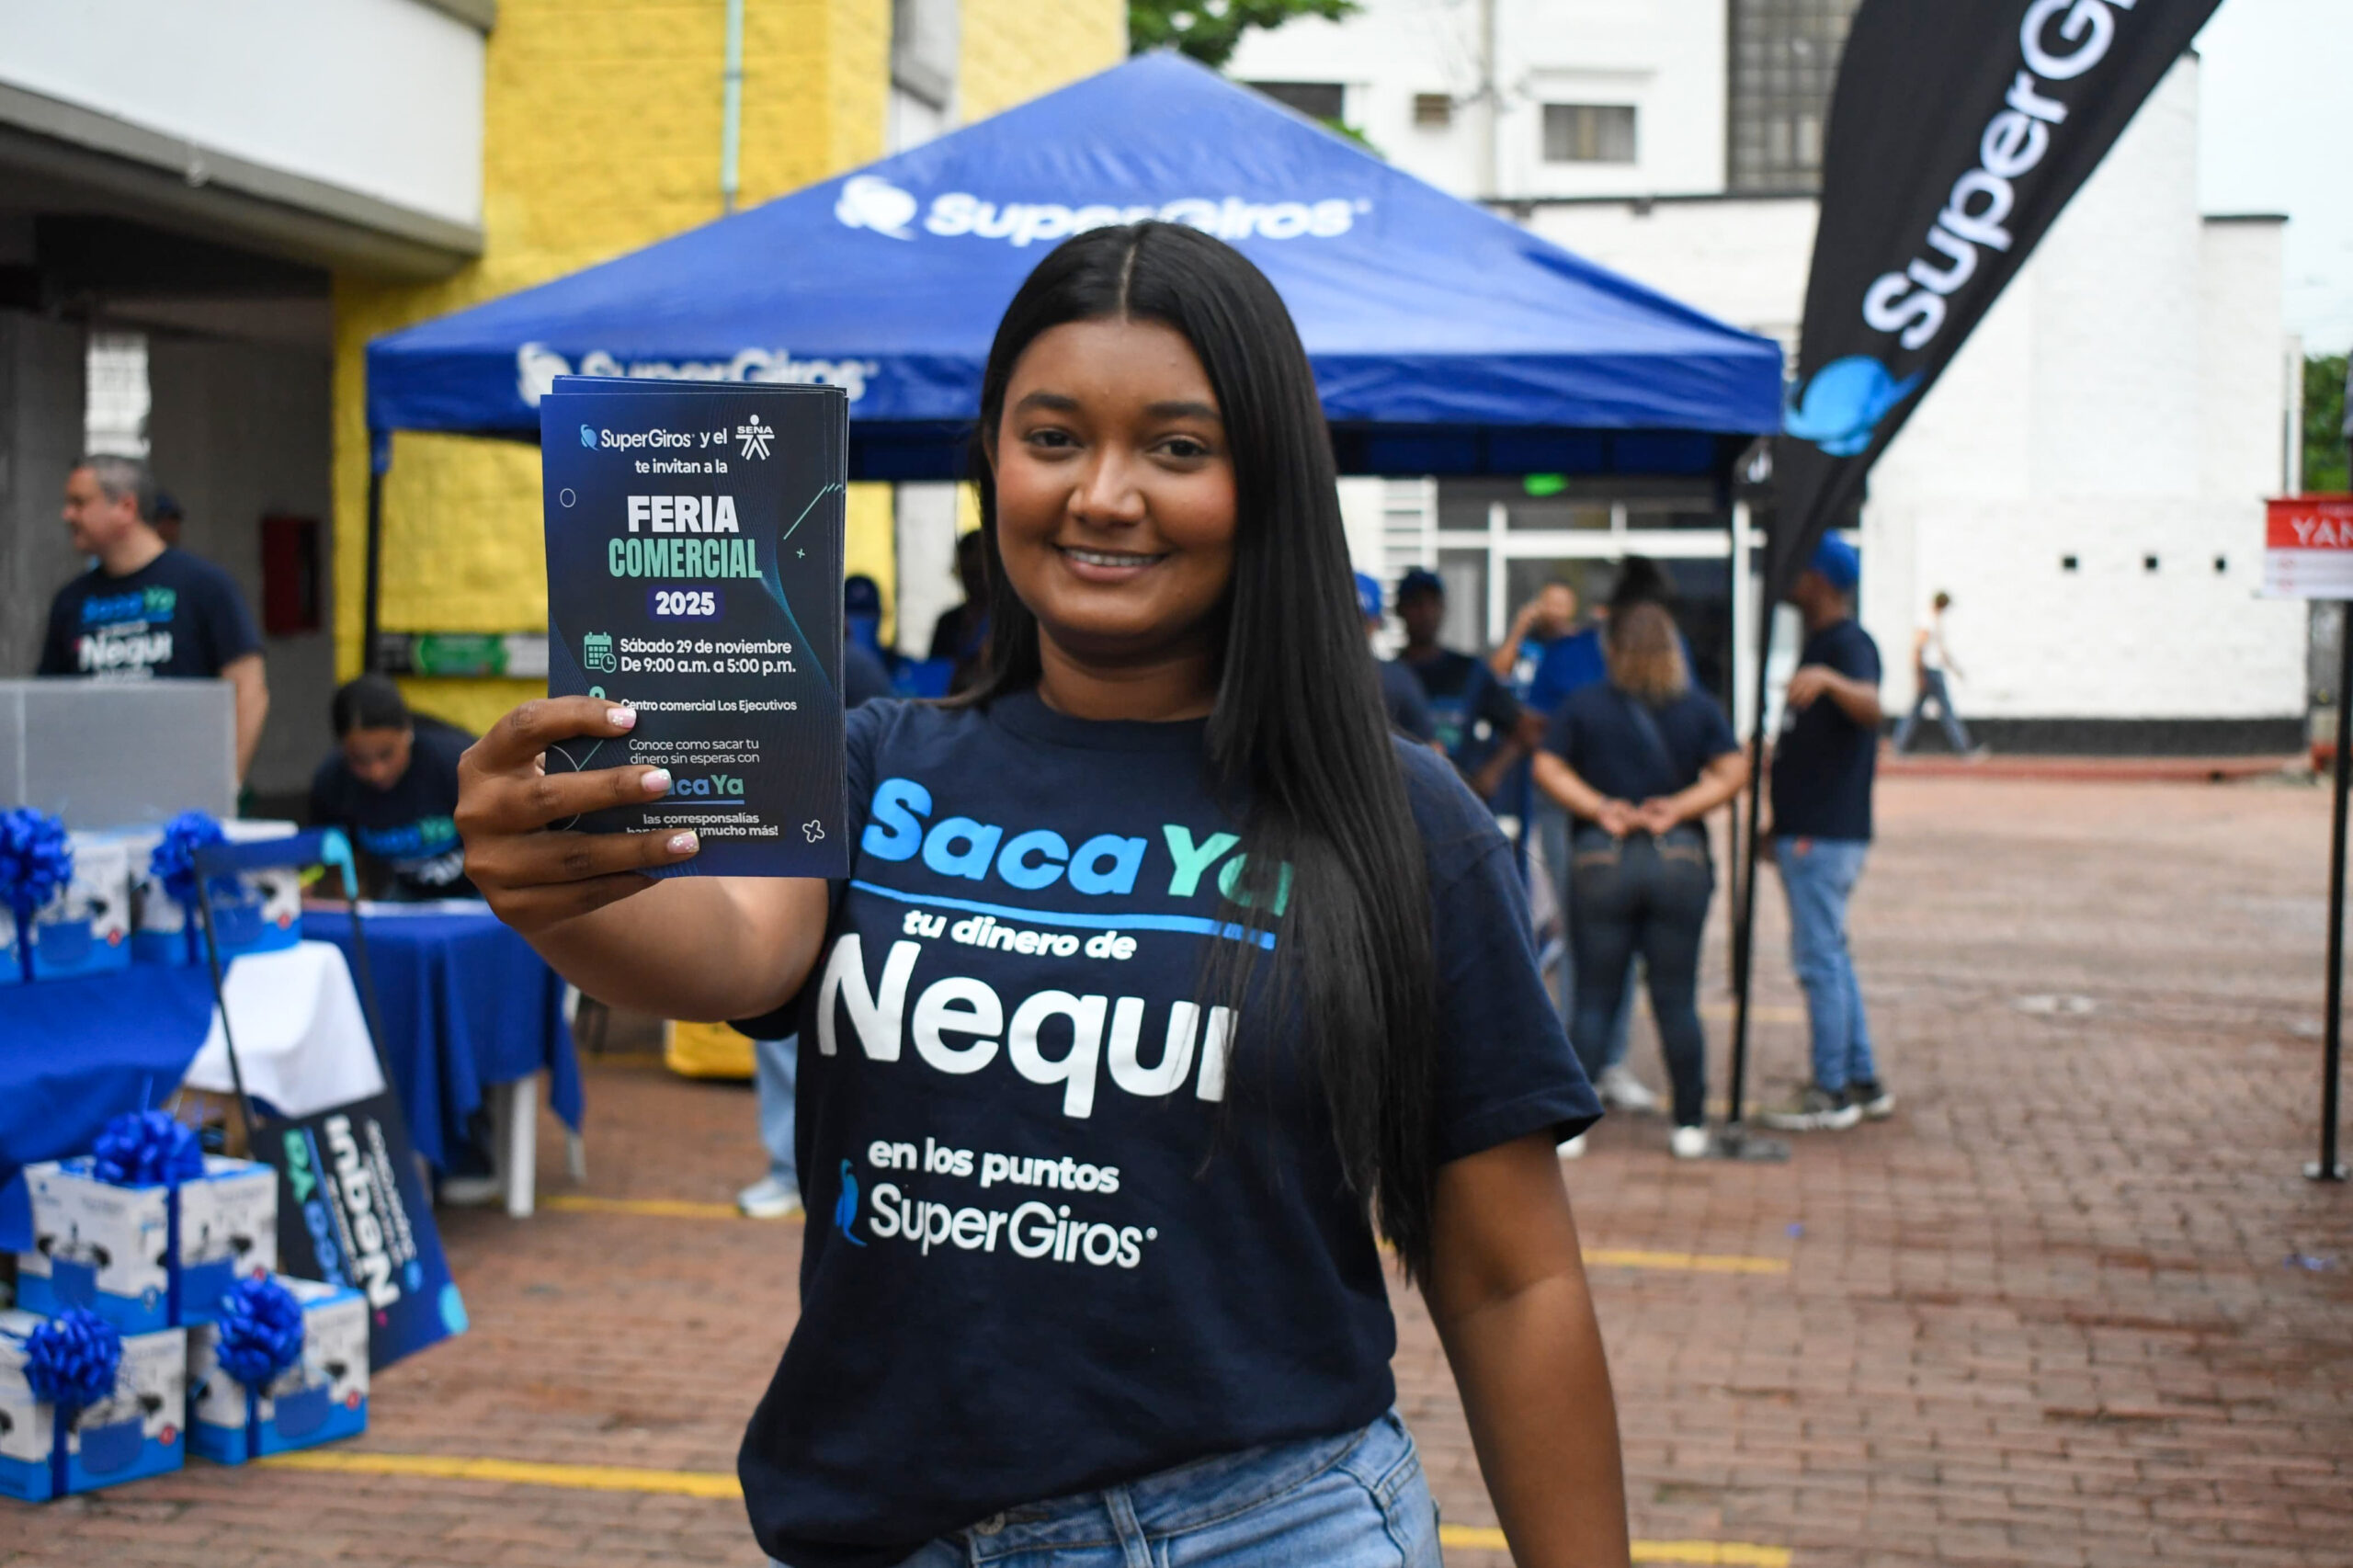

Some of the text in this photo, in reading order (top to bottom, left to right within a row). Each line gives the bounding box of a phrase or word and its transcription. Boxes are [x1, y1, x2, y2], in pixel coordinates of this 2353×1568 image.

[1863, 0, 2137, 349] SuperG
[600, 426, 773, 452] SuperGiros y el SENA
[635, 458, 728, 473] te invitan a la
[627, 495, 739, 533] FERIA
[608, 538, 763, 579] COMERCIAL
[655, 591, 715, 615] 2025
[620, 638, 791, 654] Sábado 29 de noviembre
[620, 656, 796, 676] De 9:00 a.m. a 5:00 p.m.
[661, 700, 716, 711] comercial
[718, 700, 737, 711] Los
[739, 699, 797, 713] Ejecutivos
[629, 739, 759, 750] Conoce como sacar tu
[630, 752, 759, 766] dinero sin esperas con
[668, 775, 744, 796] ca Ya
[643, 812, 759, 826] las corresponsalías
[700, 825, 779, 837] ¡mucho más!
[860, 778, 1294, 917] Saca Ya
[903, 910, 1138, 960] tu dinero de
[817, 933, 1238, 1119] Nequi
[868, 1136, 1120, 1194] en los puntos
[870, 1183, 1142, 1269] SuperGiros
